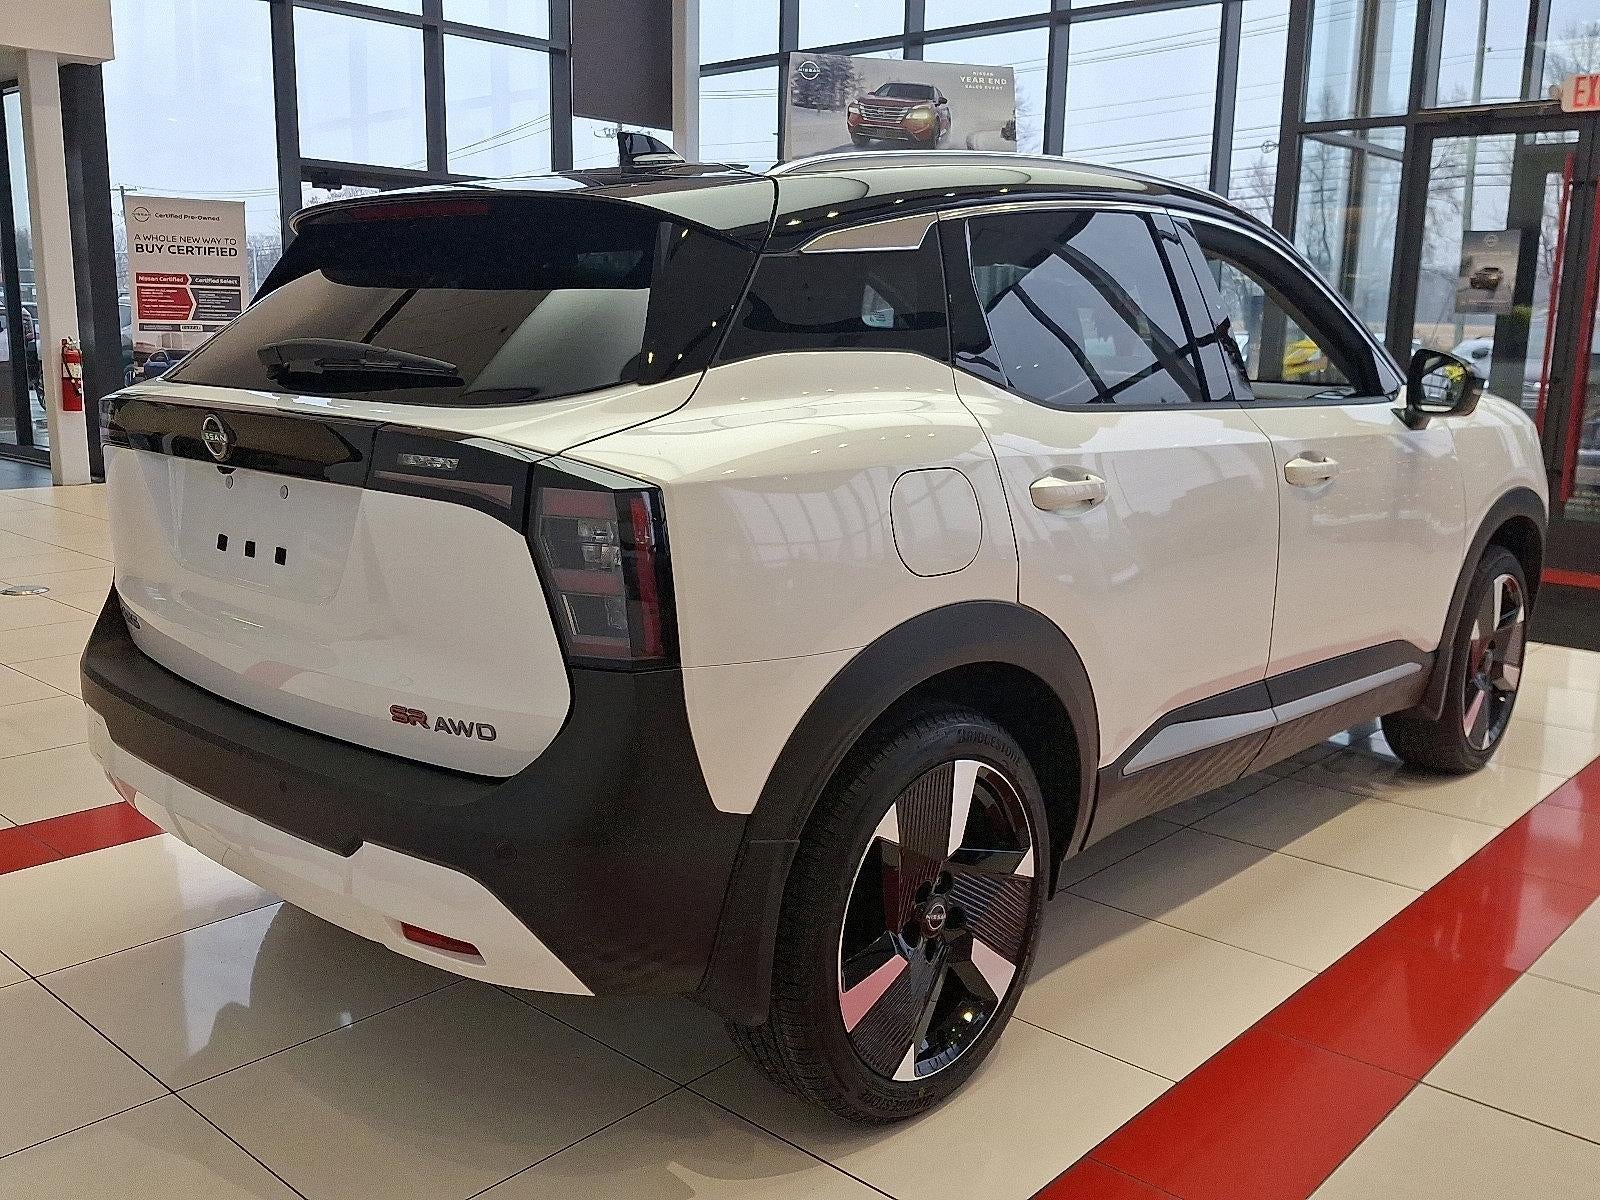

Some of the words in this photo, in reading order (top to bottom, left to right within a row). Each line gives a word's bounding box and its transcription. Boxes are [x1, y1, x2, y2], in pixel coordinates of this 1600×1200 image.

[959, 75, 985, 84] YEAR
[988, 77, 1007, 85] END
[154, 212, 182, 220] Certified
[183, 214, 220, 222] Pre-Owned
[134, 233, 141, 241] A
[142, 234, 177, 243] WHOLE
[179, 236, 202, 244] NEW
[201, 237, 222, 245] WAY
[224, 237, 237, 246] TO
[135, 243, 164, 254] BUY
[167, 244, 238, 257] CERTIFIED
[160, 275, 184, 283] Certified
[389, 704, 431, 730] SR
[433, 716, 497, 741] AWD
